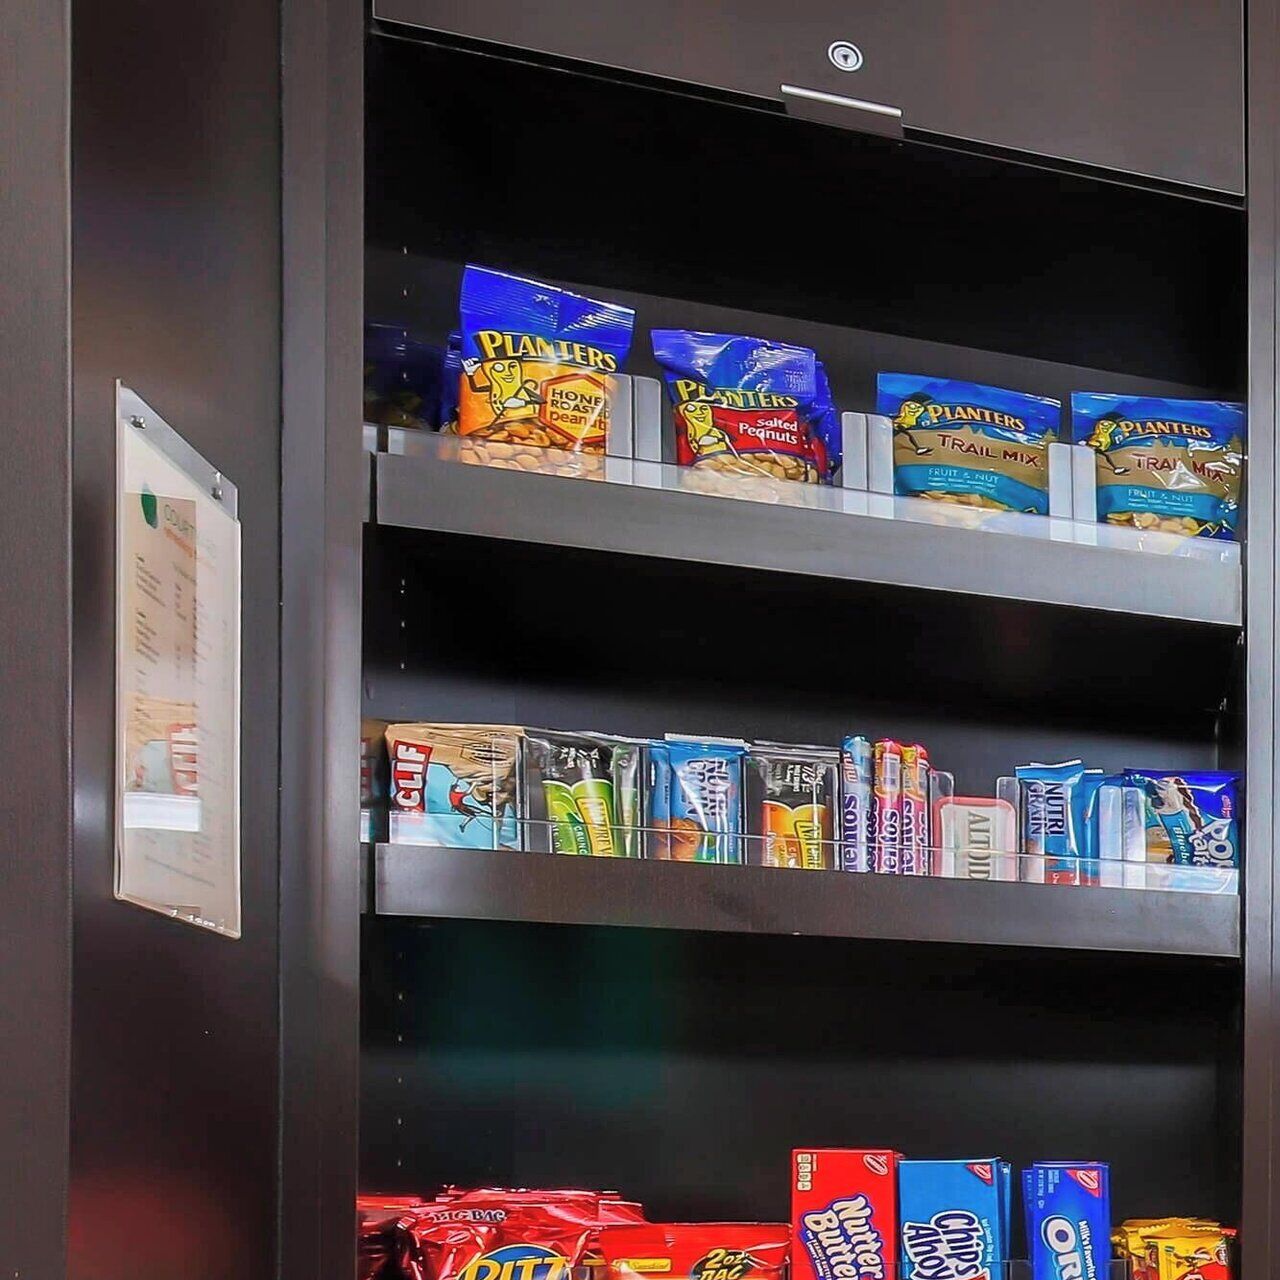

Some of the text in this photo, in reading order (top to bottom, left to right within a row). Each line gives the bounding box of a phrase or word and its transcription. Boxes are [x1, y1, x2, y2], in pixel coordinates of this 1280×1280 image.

[478, 330, 617, 372] PLANTERS
[676, 379, 798, 409] PLANTERS
[757, 418, 798, 432] salted
[928, 404, 1026, 432] PLANTERS
[1120, 420, 1212, 439] PLANTERS
[739, 423, 798, 445] Peanuts
[937, 434, 1040, 468] TRAIL MIX
[928, 467, 1001, 485] FRUIT NUT
[1171, 494, 1195, 504] NUT
[396, 744, 427, 807] CLIF
[1045, 783, 1065, 836] NUTRI
[832, 1195, 885, 1280] Nutter
[931, 1212, 984, 1277] Chips
